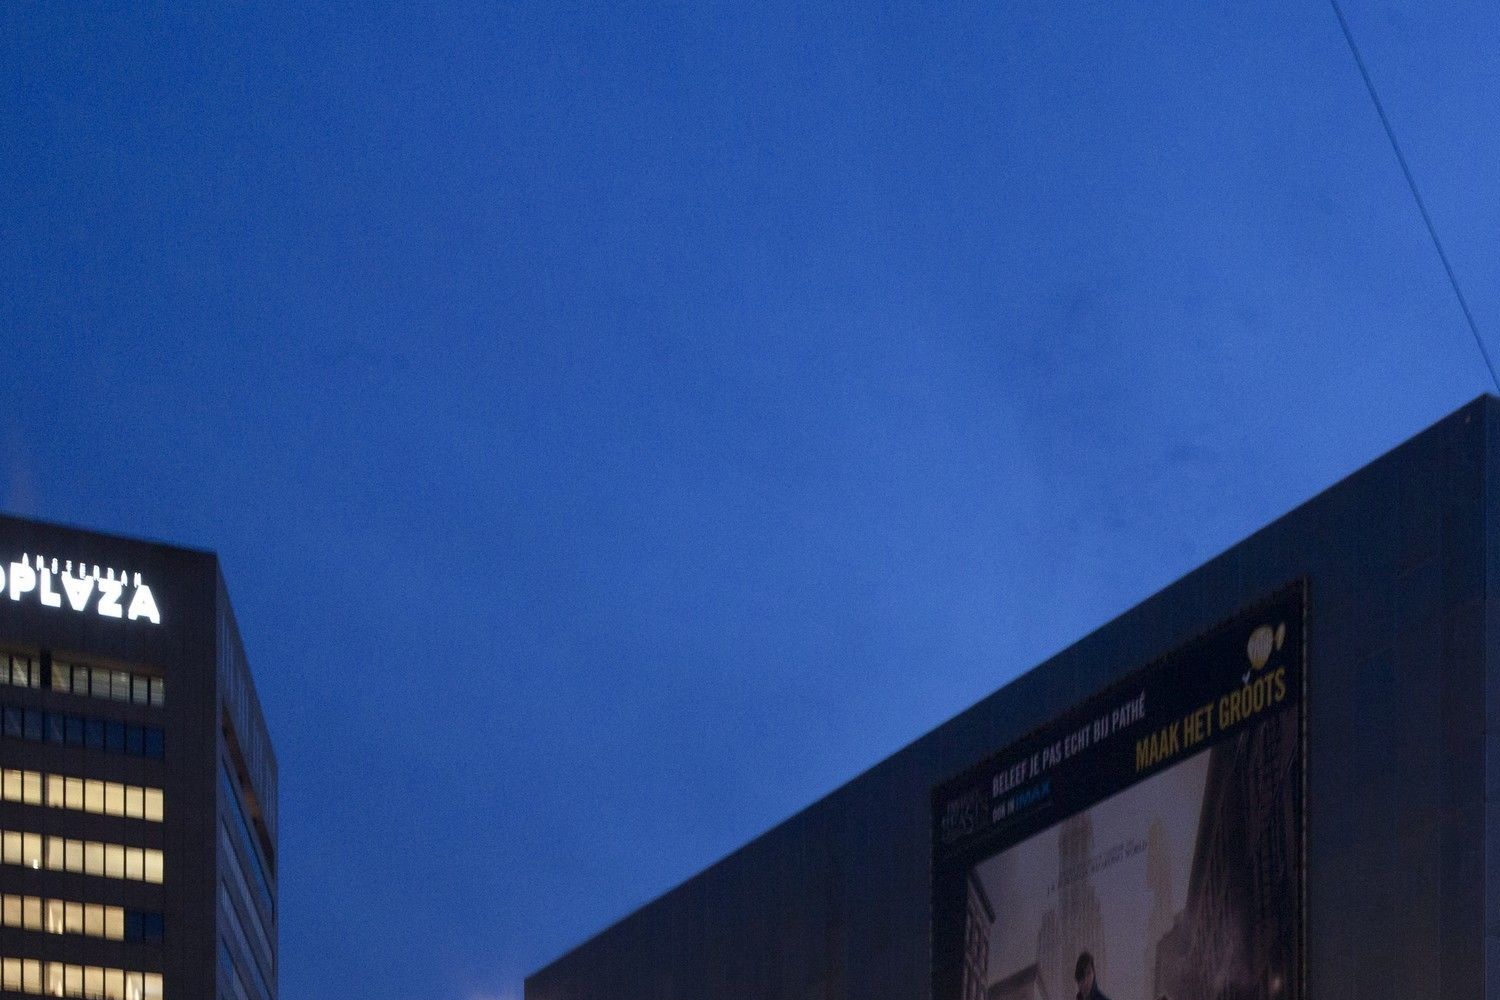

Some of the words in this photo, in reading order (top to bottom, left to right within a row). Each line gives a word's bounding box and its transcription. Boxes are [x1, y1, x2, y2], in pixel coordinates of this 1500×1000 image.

[0, 562, 160, 624] PLAZA
[1042, 740, 1062, 770] PAS
[1064, 724, 1090, 759] ECHT
[1136, 720, 1179, 772] MAAK
[1184, 700, 1214, 747] HET
[1219, 666, 1286, 730] GROOTS
